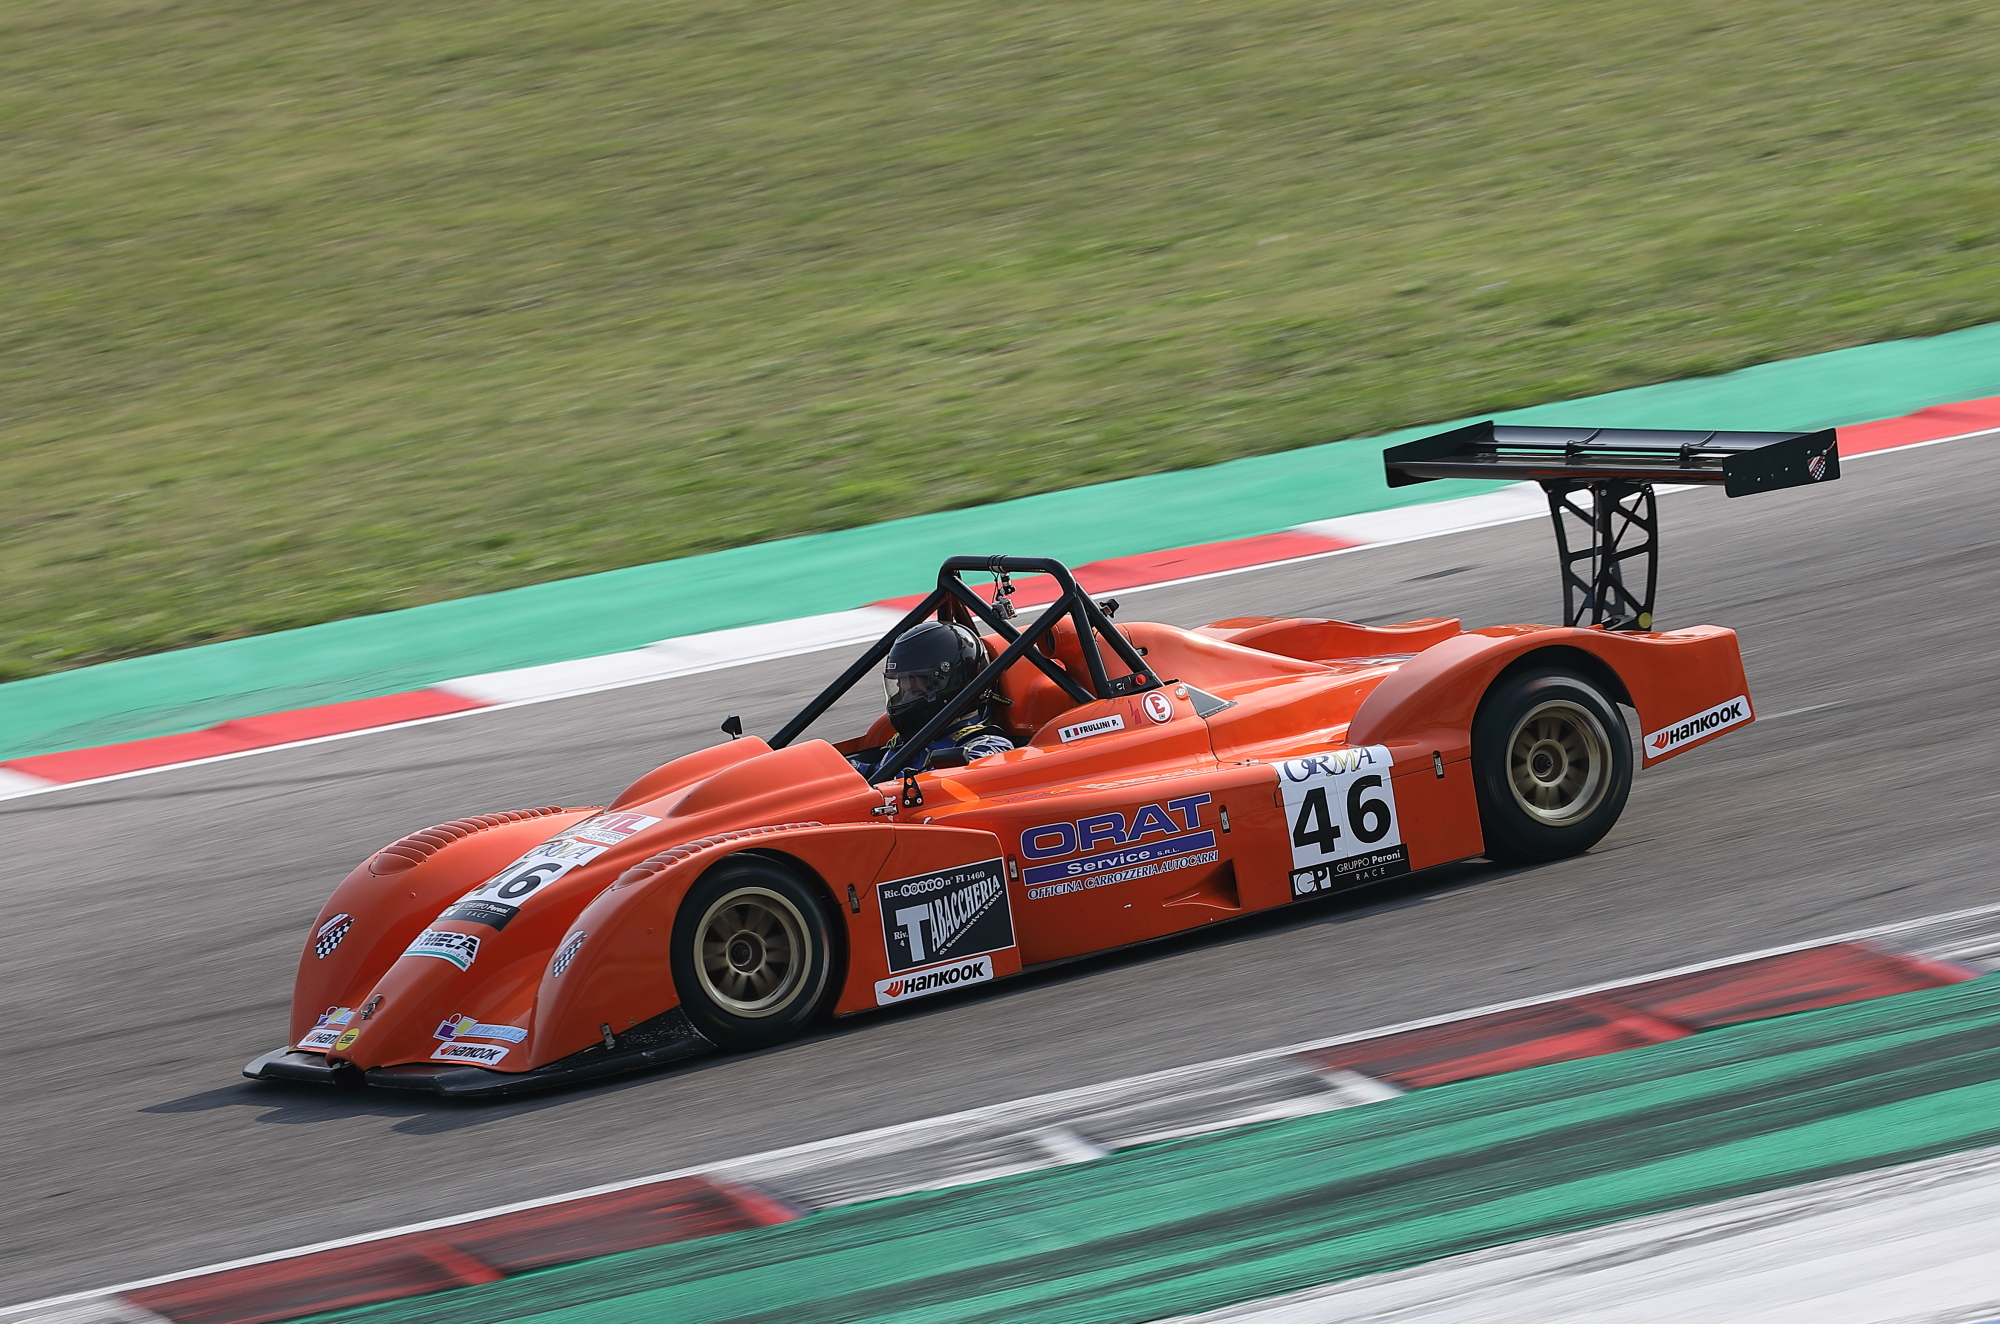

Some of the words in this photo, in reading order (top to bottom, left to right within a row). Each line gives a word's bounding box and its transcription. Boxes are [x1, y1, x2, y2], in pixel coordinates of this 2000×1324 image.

[1150, 696, 1165, 714] E
[1079, 719, 1111, 734] FRULLINI
[1111, 719, 1119, 727] P.
[1283, 747, 1377, 782] ORMA
[1021, 792, 1212, 861] ORAT
[1292, 774, 1392, 855] 46
[1066, 849, 1152, 875] Service
[1336, 857, 1370, 872] GRUPPO
[1372, 849, 1401, 864] Peroni
[1356, 867, 1386, 881] RACE
[884, 890, 900, 899] Ric.
[955, 874, 966, 884] FI
[966, 870, 986, 882] 1460
[1027, 880, 1084, 900] OFFICINA
[1084, 863, 1160, 890] CARROZZERIA
[1160, 850, 1219, 874] AUTOCARRI
[486, 904, 510, 914] Peroni
[895, 875, 1001, 962] TABACCHERIA
[945, 910, 984, 948] Sommariva
[984, 890, 1004, 910] Fabio
[894, 932, 908, 940] Riv.
